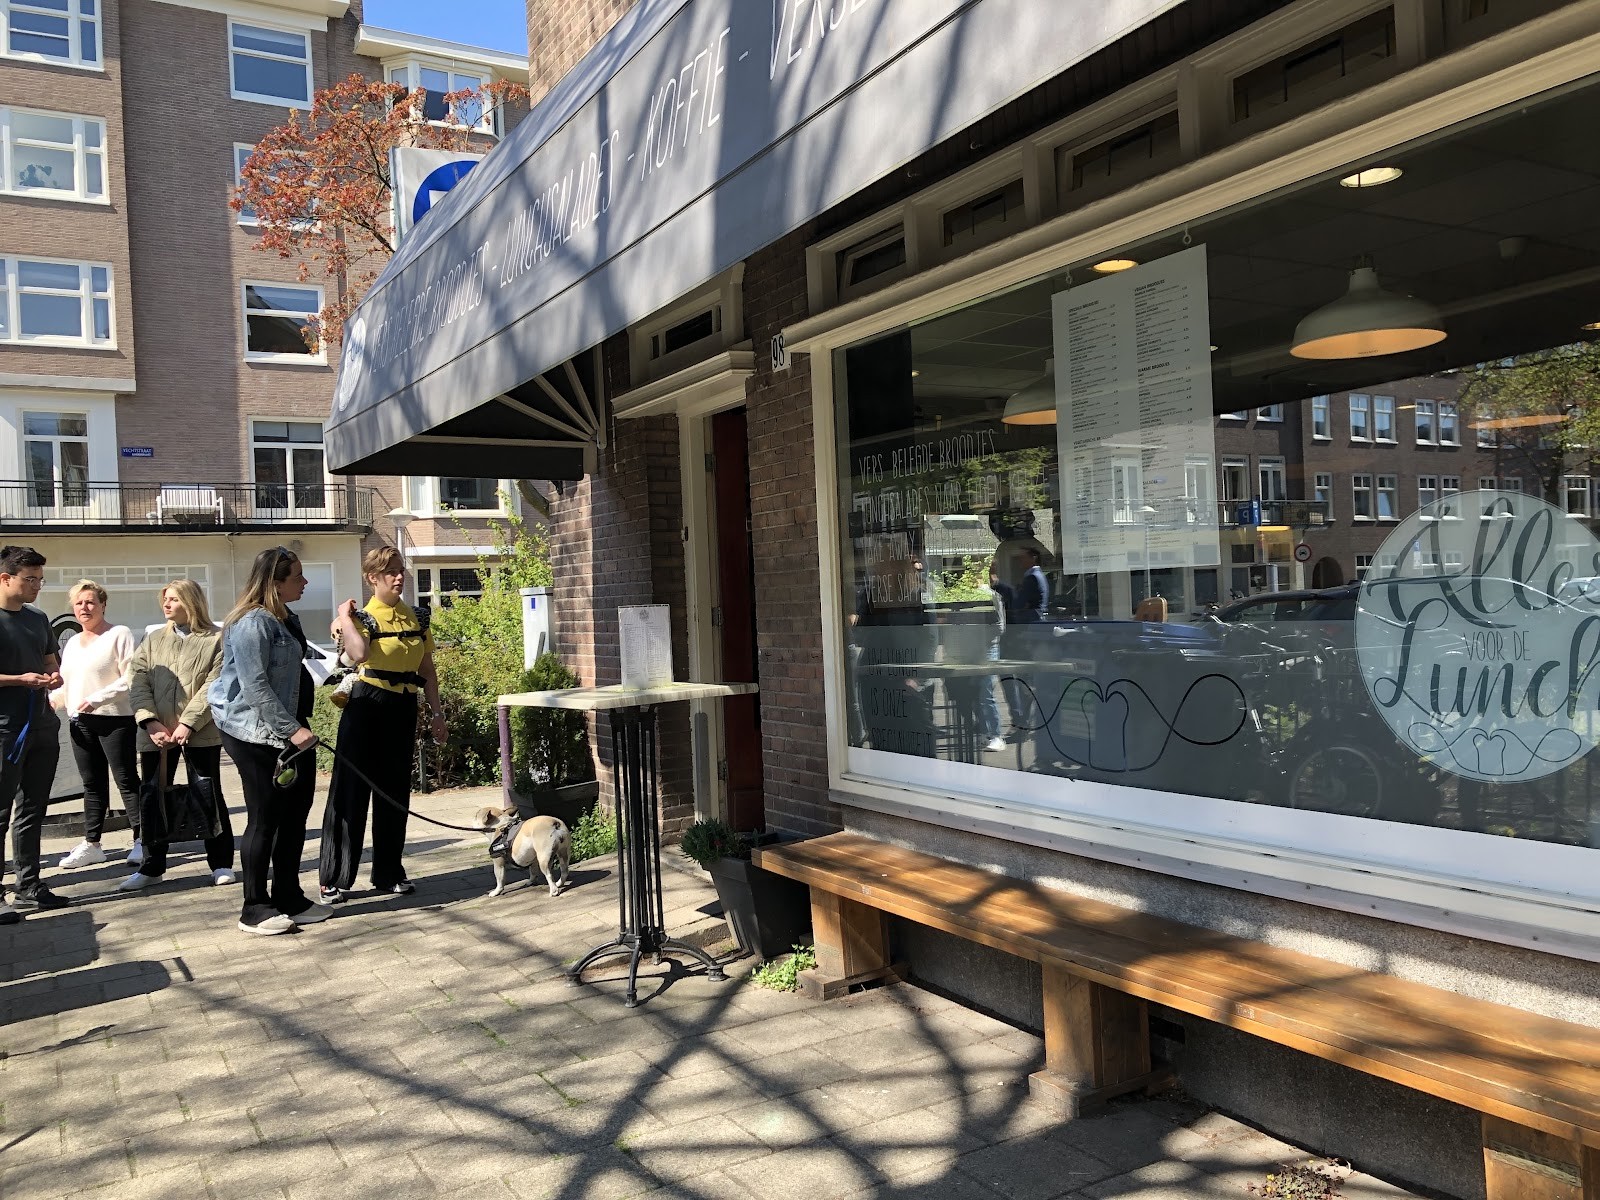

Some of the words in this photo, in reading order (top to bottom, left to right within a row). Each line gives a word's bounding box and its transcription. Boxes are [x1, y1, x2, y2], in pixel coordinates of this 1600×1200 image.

[429, 240, 490, 336] BROODJES
[500, 130, 619, 289] LUNCHSALADES
[641, 27, 730, 182] KOFFIE
[772, 335, 785, 369] 98
[858, 453, 883, 486] VERS
[892, 441, 935, 480] BELEGDE
[938, 427, 997, 471] BROODJES
[934, 480, 964, 514] NAAR
[889, 530, 916, 562] AWAY
[863, 573, 893, 604] VERSE
[1465, 631, 1505, 661] VOOR
[1513, 630, 1532, 661] DE
[886, 646, 918, 678] LUNCH
[870, 687, 879, 719] IS
[882, 688, 909, 718] ONZE
